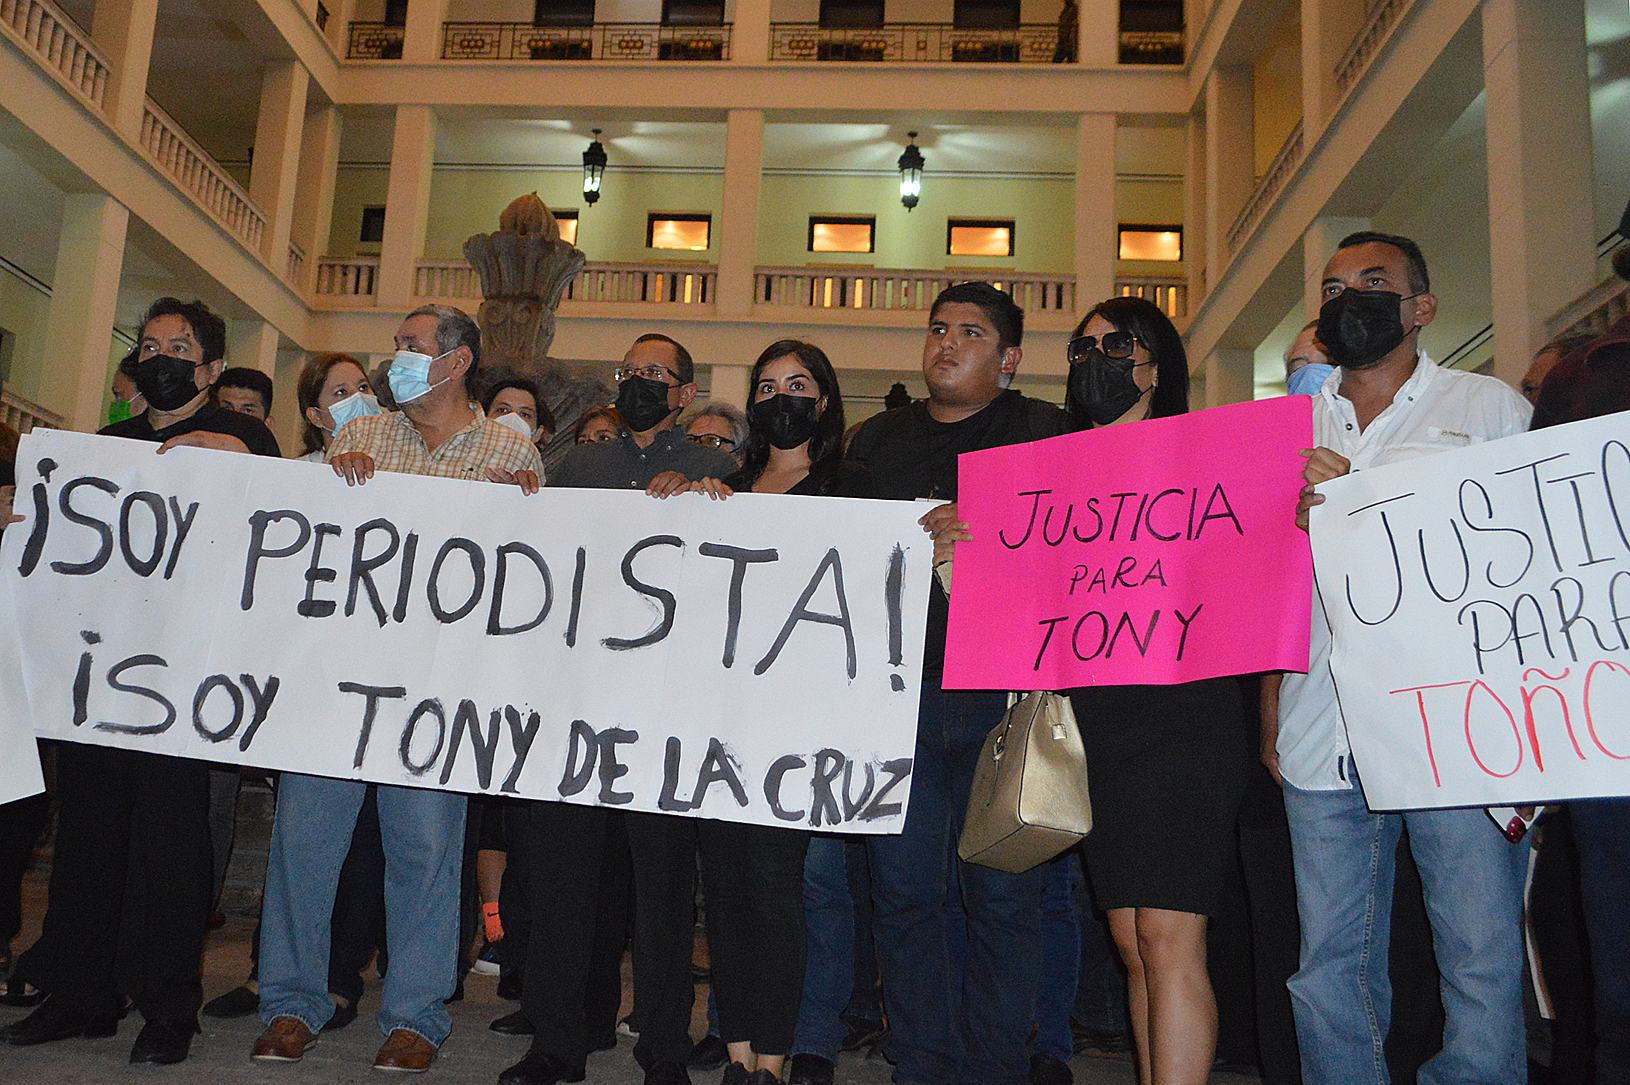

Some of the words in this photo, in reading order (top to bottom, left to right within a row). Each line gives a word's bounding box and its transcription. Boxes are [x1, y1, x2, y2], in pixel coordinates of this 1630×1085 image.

[998, 482, 1244, 550] JUSTICIA
[240, 509, 907, 692] PERIODISTA!
[1068, 556, 1168, 596] PARA
[1033, 603, 1203, 672] TONY
[1457, 570, 1630, 675] PARA
[338, 681, 541, 794] TONY
[557, 719, 640, 805] DE
[657, 736, 749, 812] LA
[762, 747, 913, 827] CRUZ
